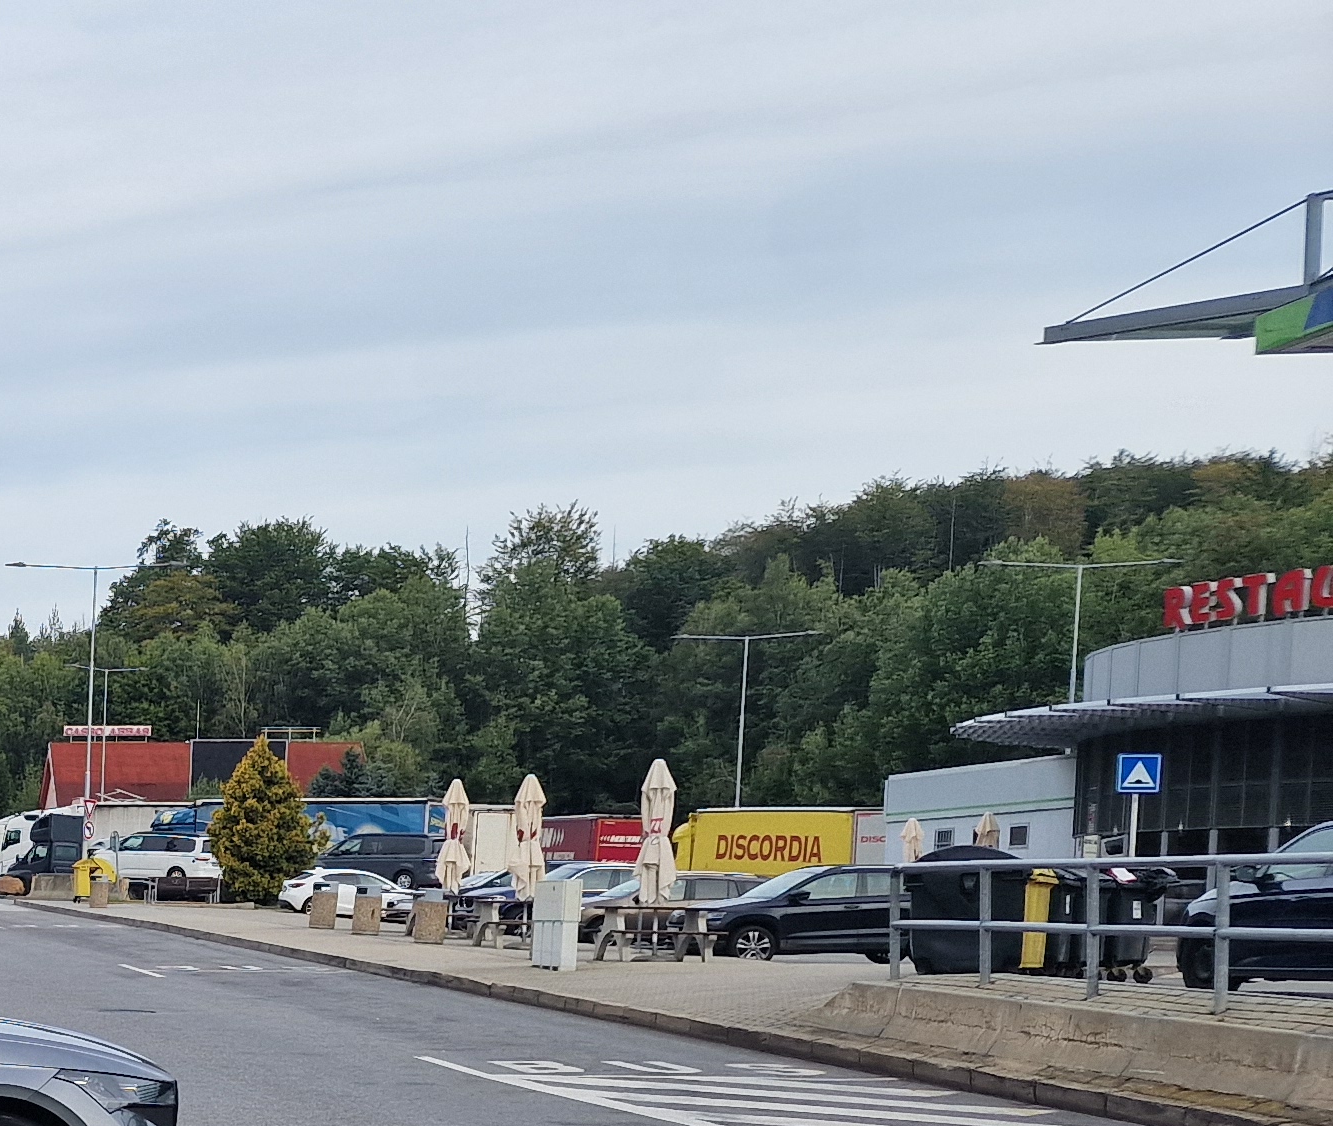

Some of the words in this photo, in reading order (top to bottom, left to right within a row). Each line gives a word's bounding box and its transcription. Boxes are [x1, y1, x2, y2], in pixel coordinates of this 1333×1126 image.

[860, 835, 887, 844] DISC
[714, 834, 823, 864] DISCORDIA
[486, 1060, 827, 1076] BUS
